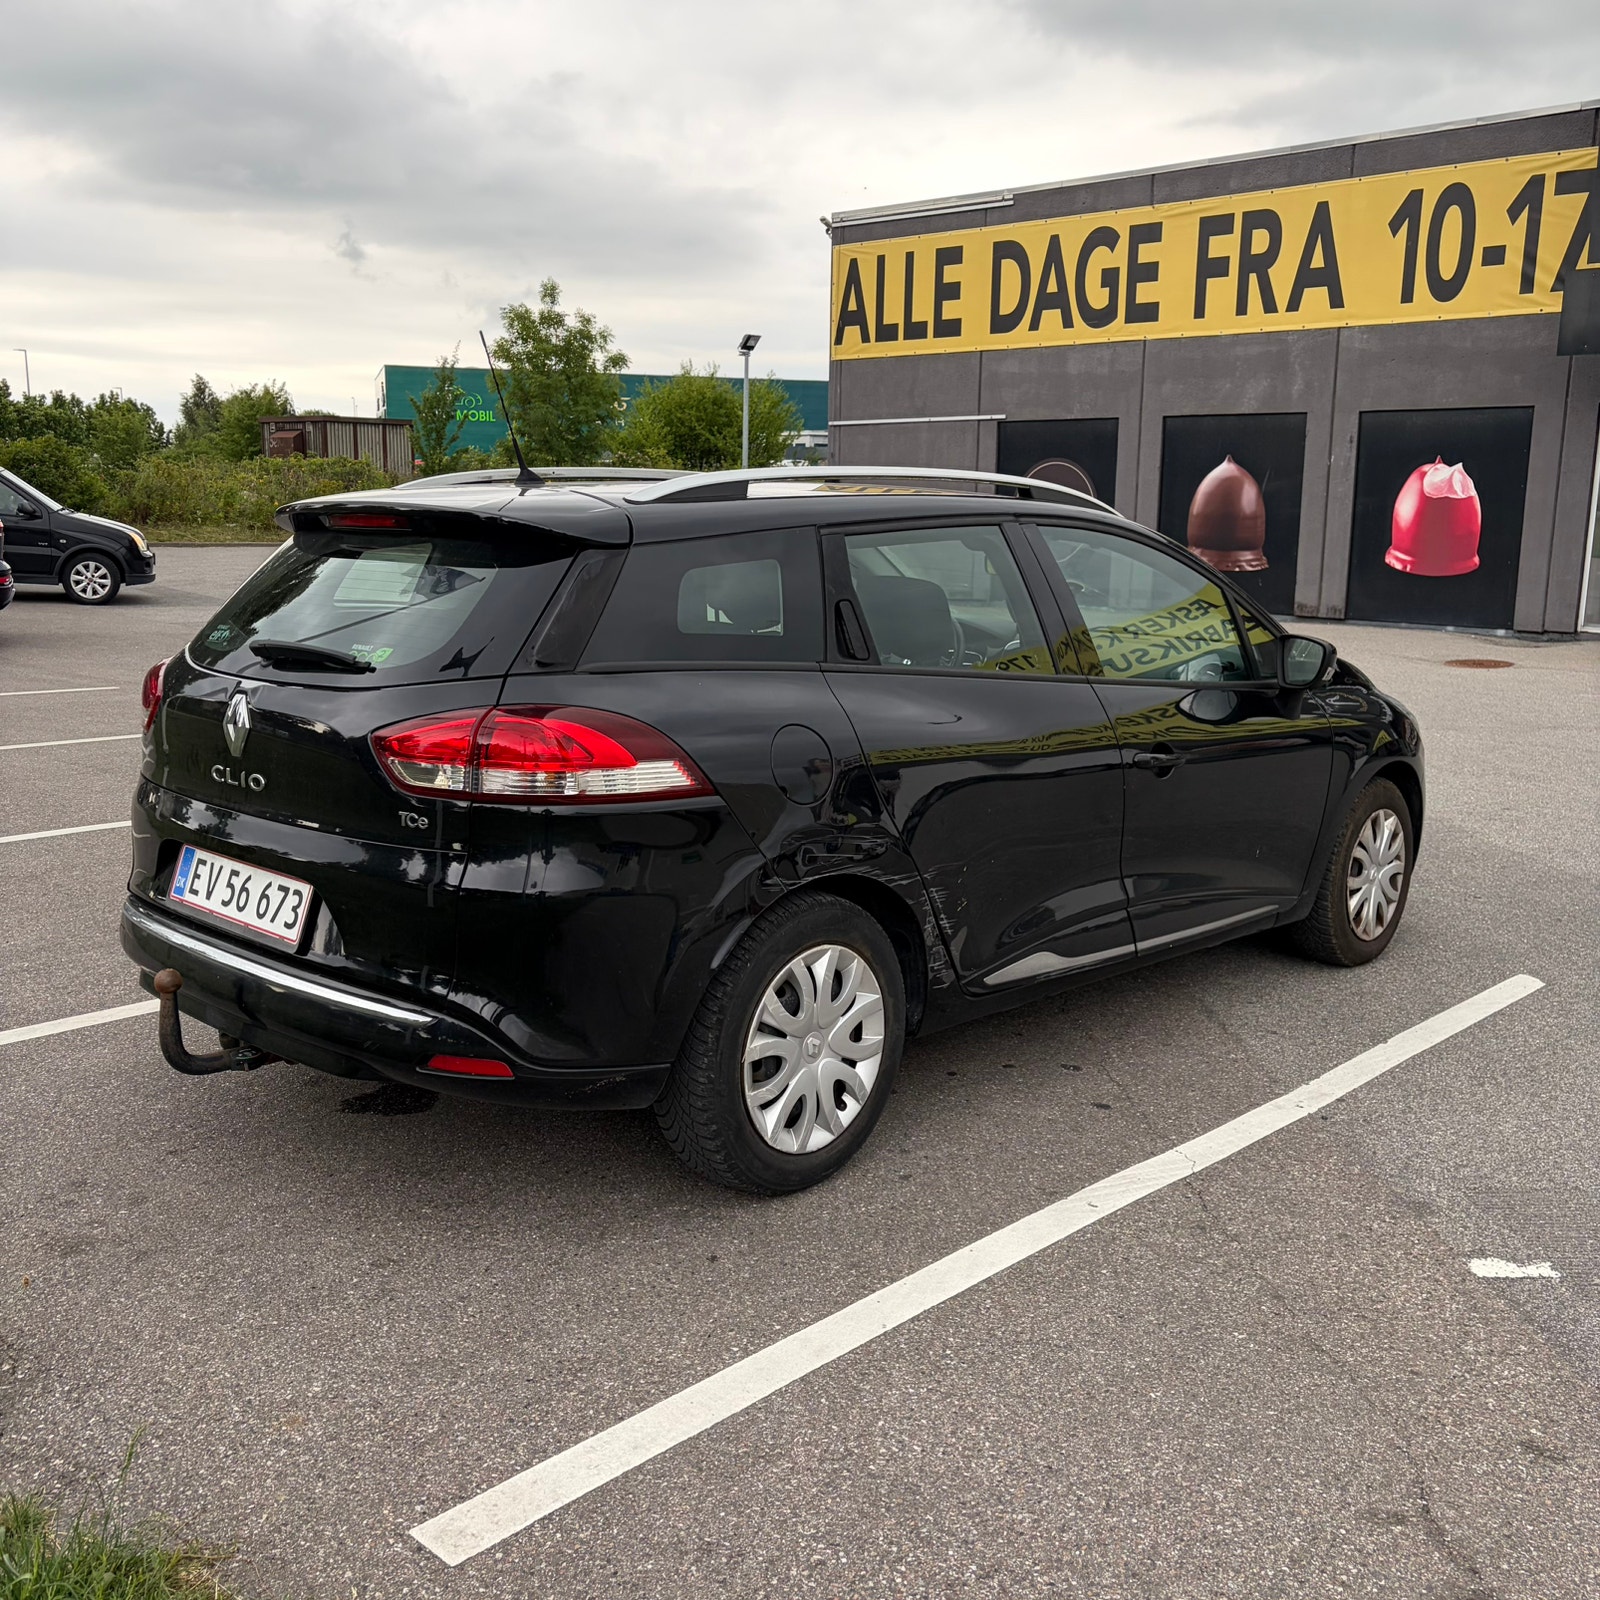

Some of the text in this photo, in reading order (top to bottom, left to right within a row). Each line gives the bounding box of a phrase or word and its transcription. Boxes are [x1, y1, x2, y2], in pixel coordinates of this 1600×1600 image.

[833, 167, 1597, 346] ALLE DAGE FRA 10-17
[456, 410, 497, 422] MOBIL
[210, 764, 267, 793] CLIO
[398, 811, 430, 830] TCe
[175, 875, 186, 888] DK
[188, 857, 304, 931] EV 56 673
